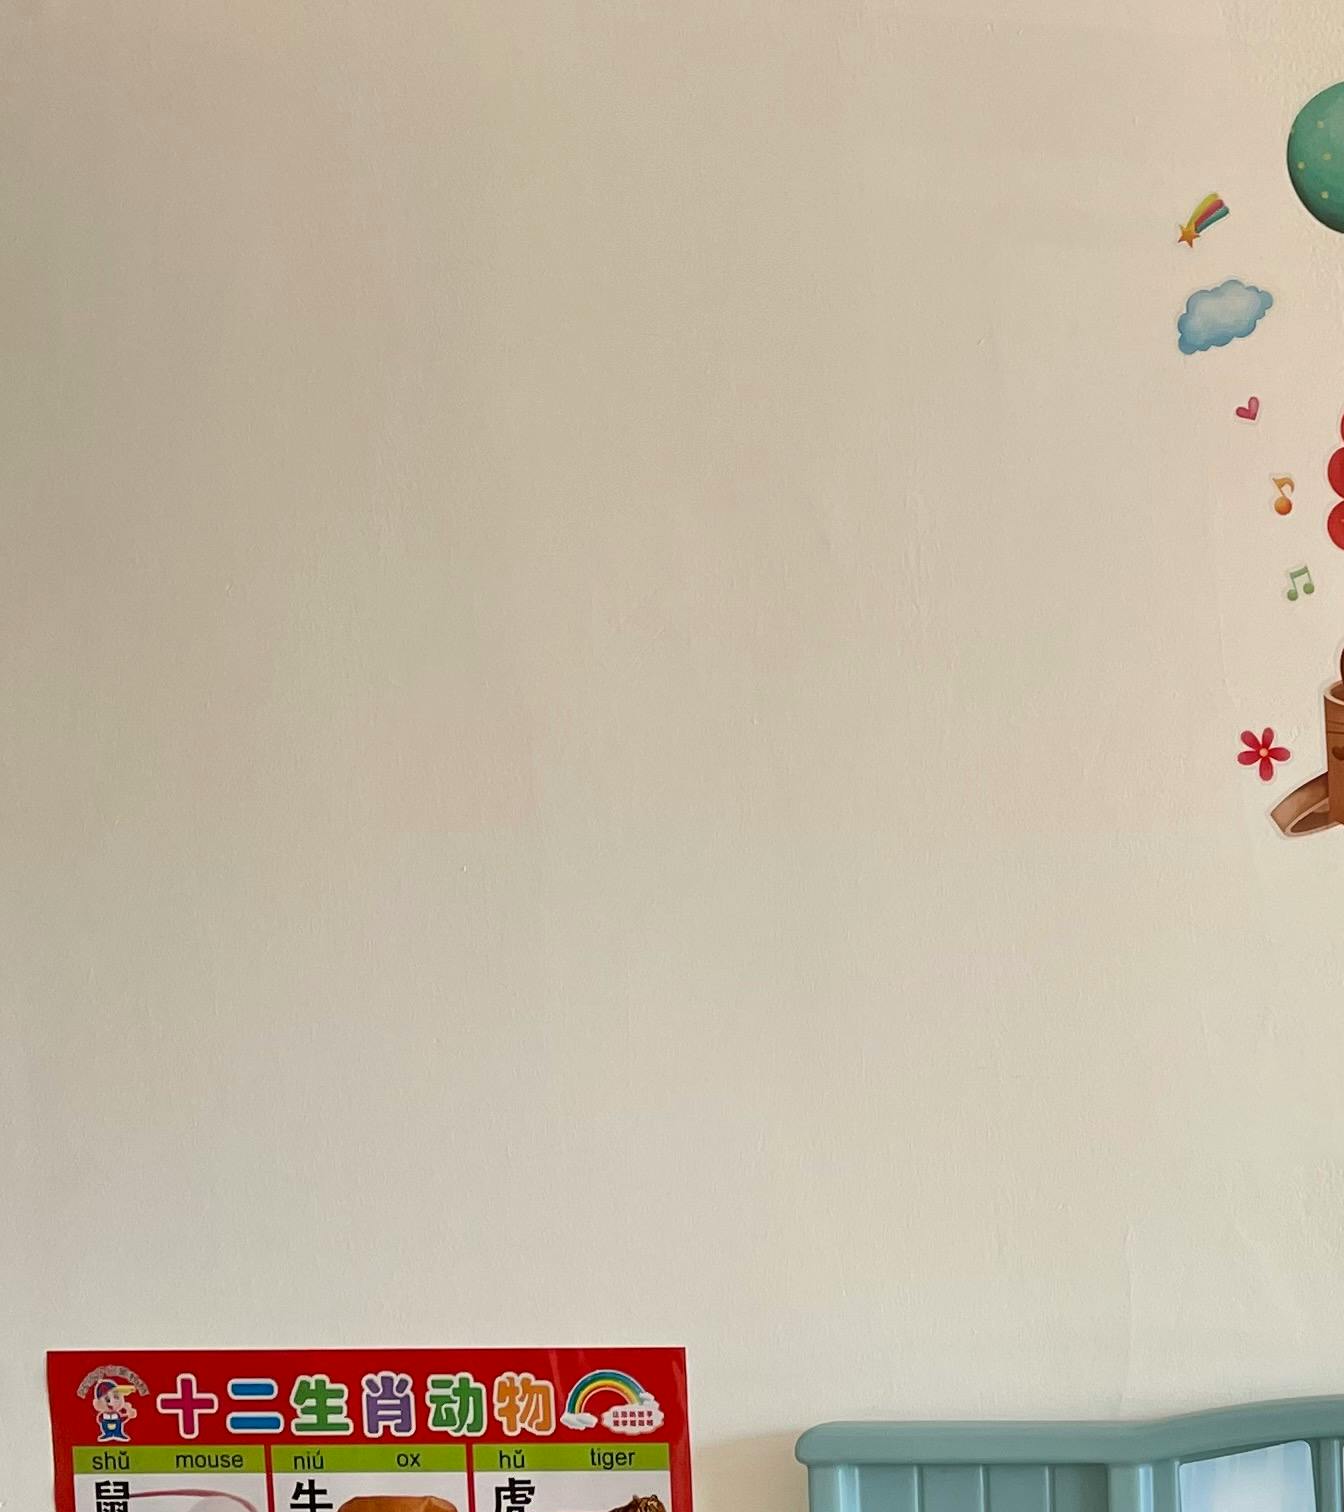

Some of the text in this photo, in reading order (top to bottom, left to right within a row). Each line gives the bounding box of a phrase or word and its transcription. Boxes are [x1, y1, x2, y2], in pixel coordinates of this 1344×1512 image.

[157, 1371, 557, 1438] 十二生肖动物
[175, 1452, 244, 1469] mouse
[396, 1453, 421, 1467] ox
[590, 1448, 636, 1470] tiger
